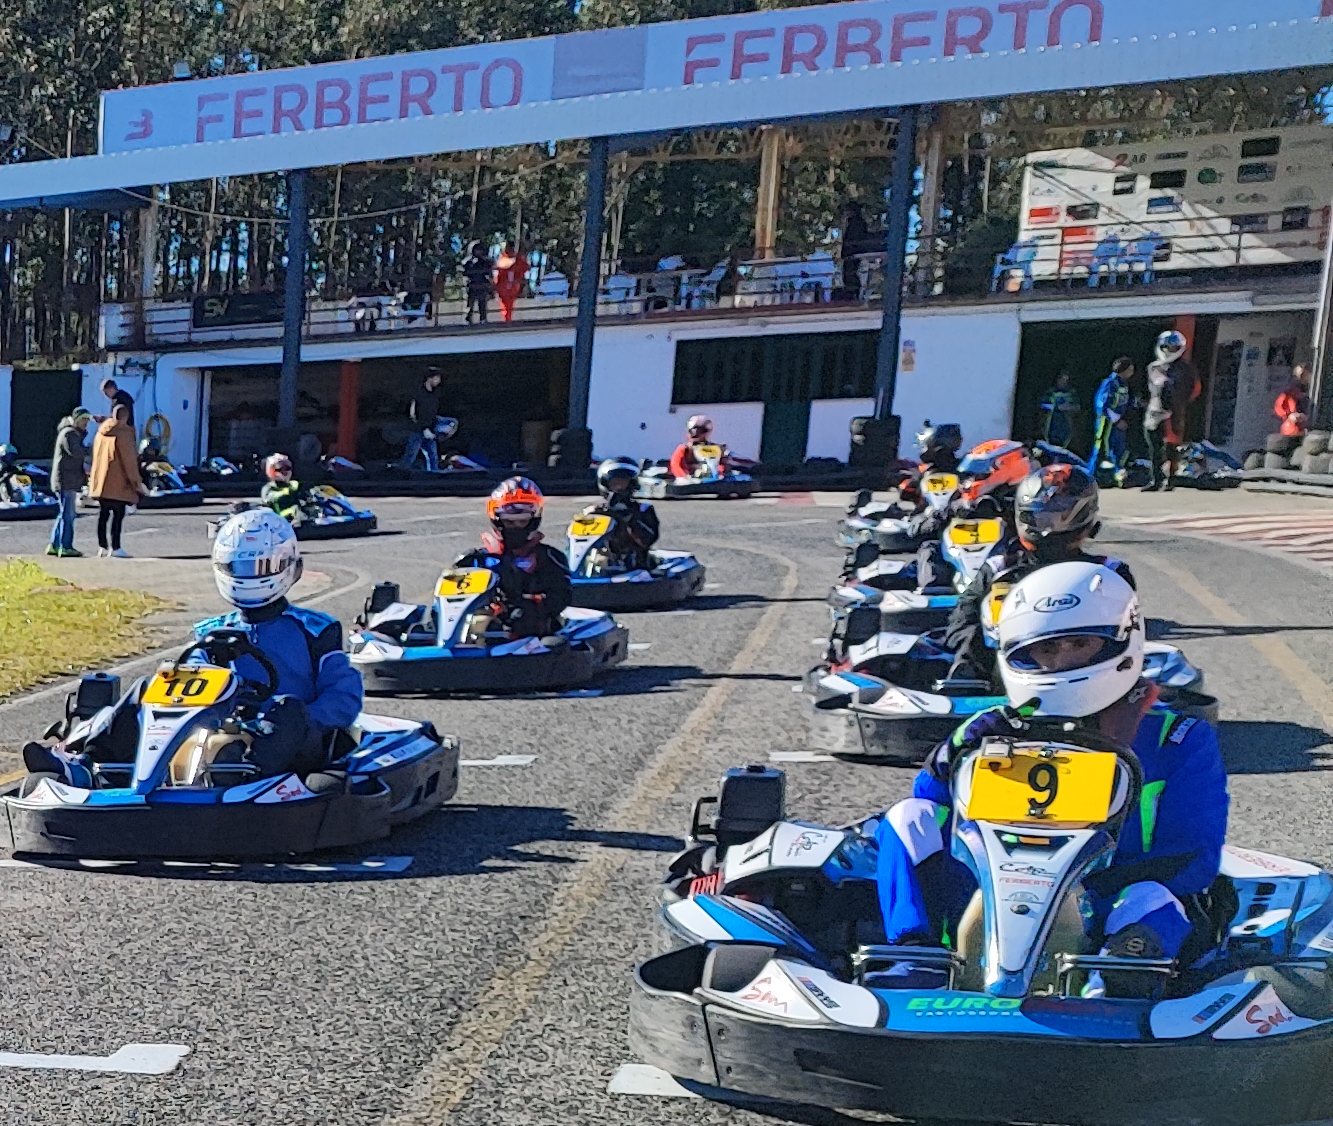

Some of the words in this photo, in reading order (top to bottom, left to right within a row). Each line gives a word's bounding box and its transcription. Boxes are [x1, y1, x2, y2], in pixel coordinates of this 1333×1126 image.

[194, 57, 524, 143] FERBERTO
[163, 678, 209, 696] 10
[1027, 763, 1058, 809] 9
